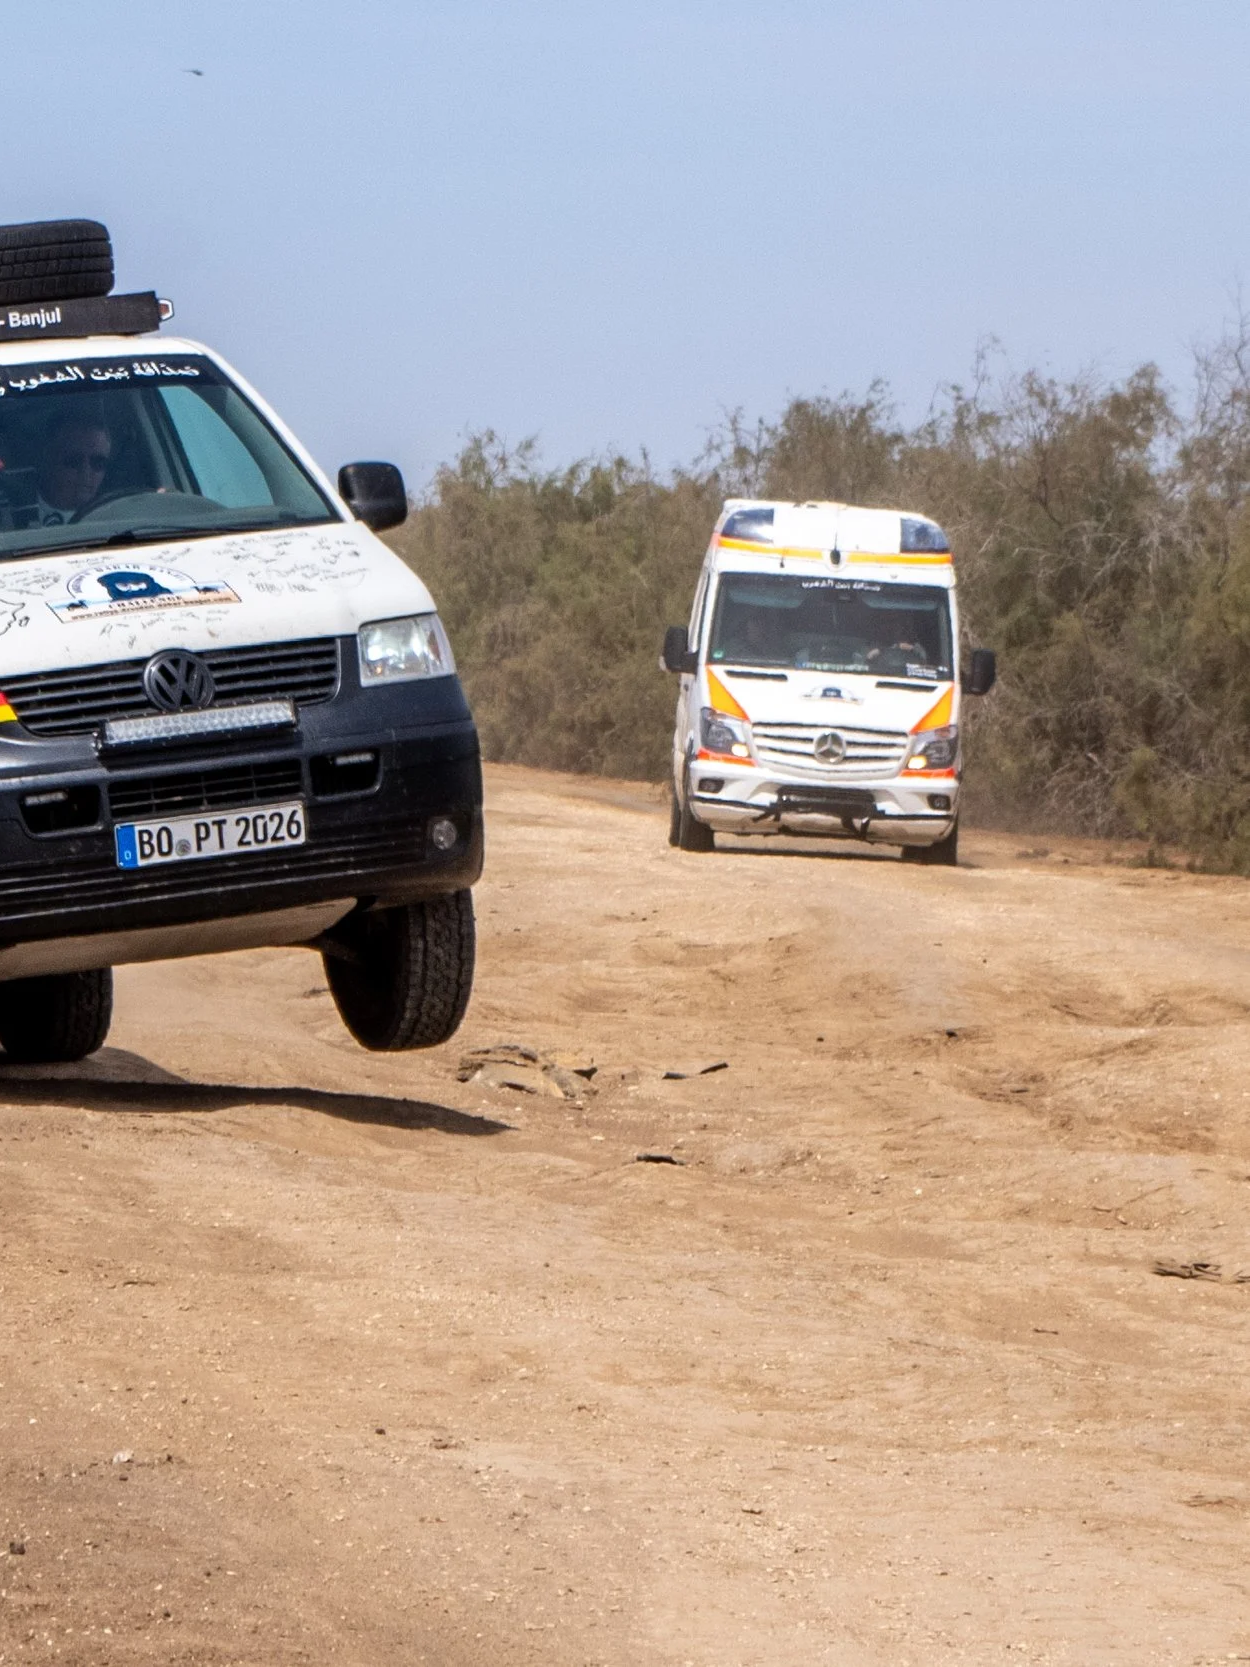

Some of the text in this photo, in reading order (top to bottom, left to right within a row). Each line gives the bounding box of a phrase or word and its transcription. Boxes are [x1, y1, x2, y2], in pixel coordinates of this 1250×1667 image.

[8, 307, 61, 329] Banjul
[138, 809, 301, 860] BO PT 2026
